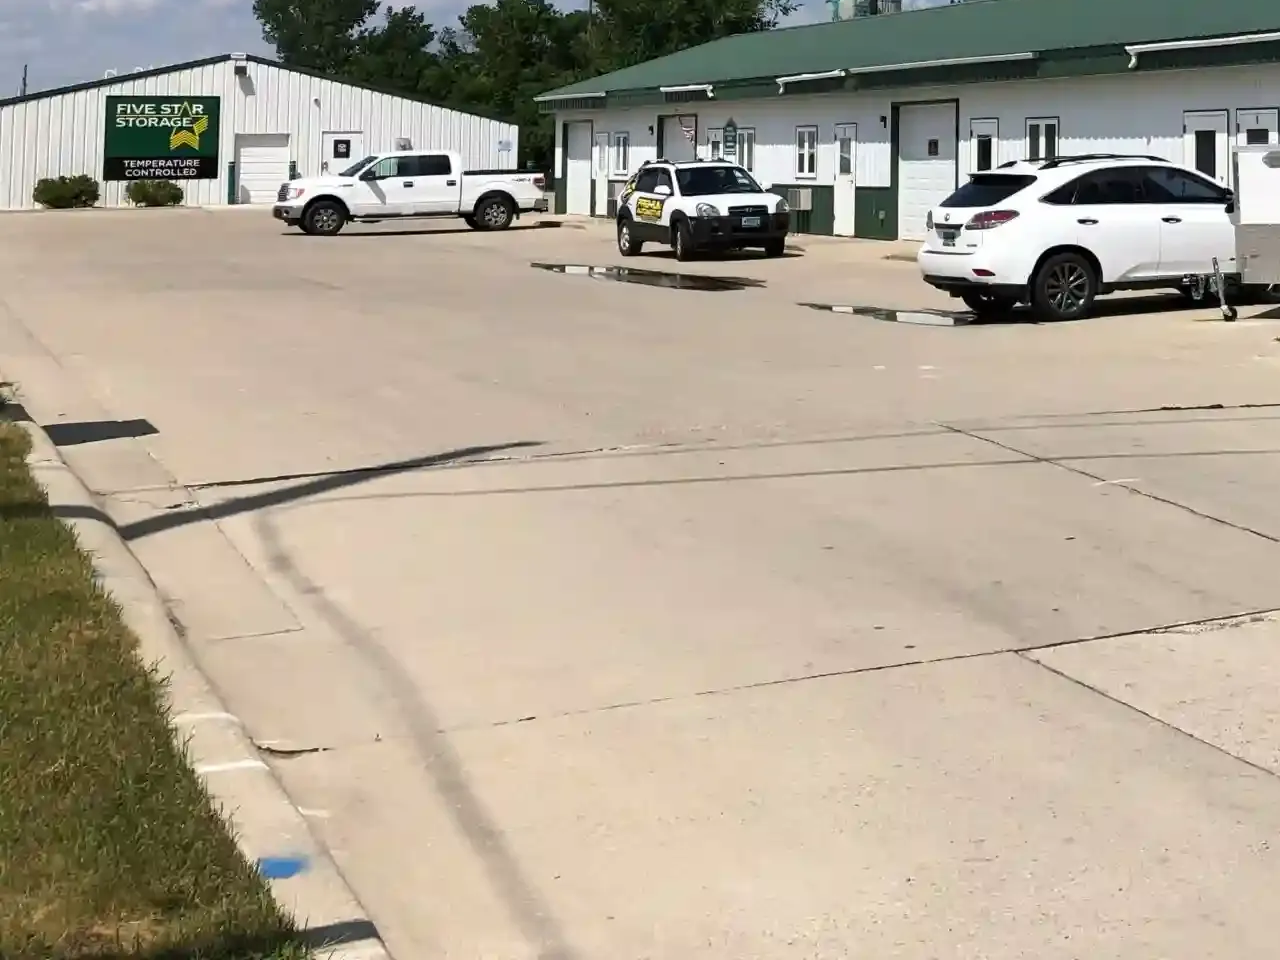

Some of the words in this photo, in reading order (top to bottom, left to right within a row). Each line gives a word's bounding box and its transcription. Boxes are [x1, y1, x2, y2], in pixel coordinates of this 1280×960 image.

[116, 103, 156, 115] FIVE
[160, 101, 204, 115] STAR
[115, 117, 194, 128] STORAGE
[123, 159, 201, 169] TEMPERATURE
[125, 168, 198, 177] CONTROLLED
